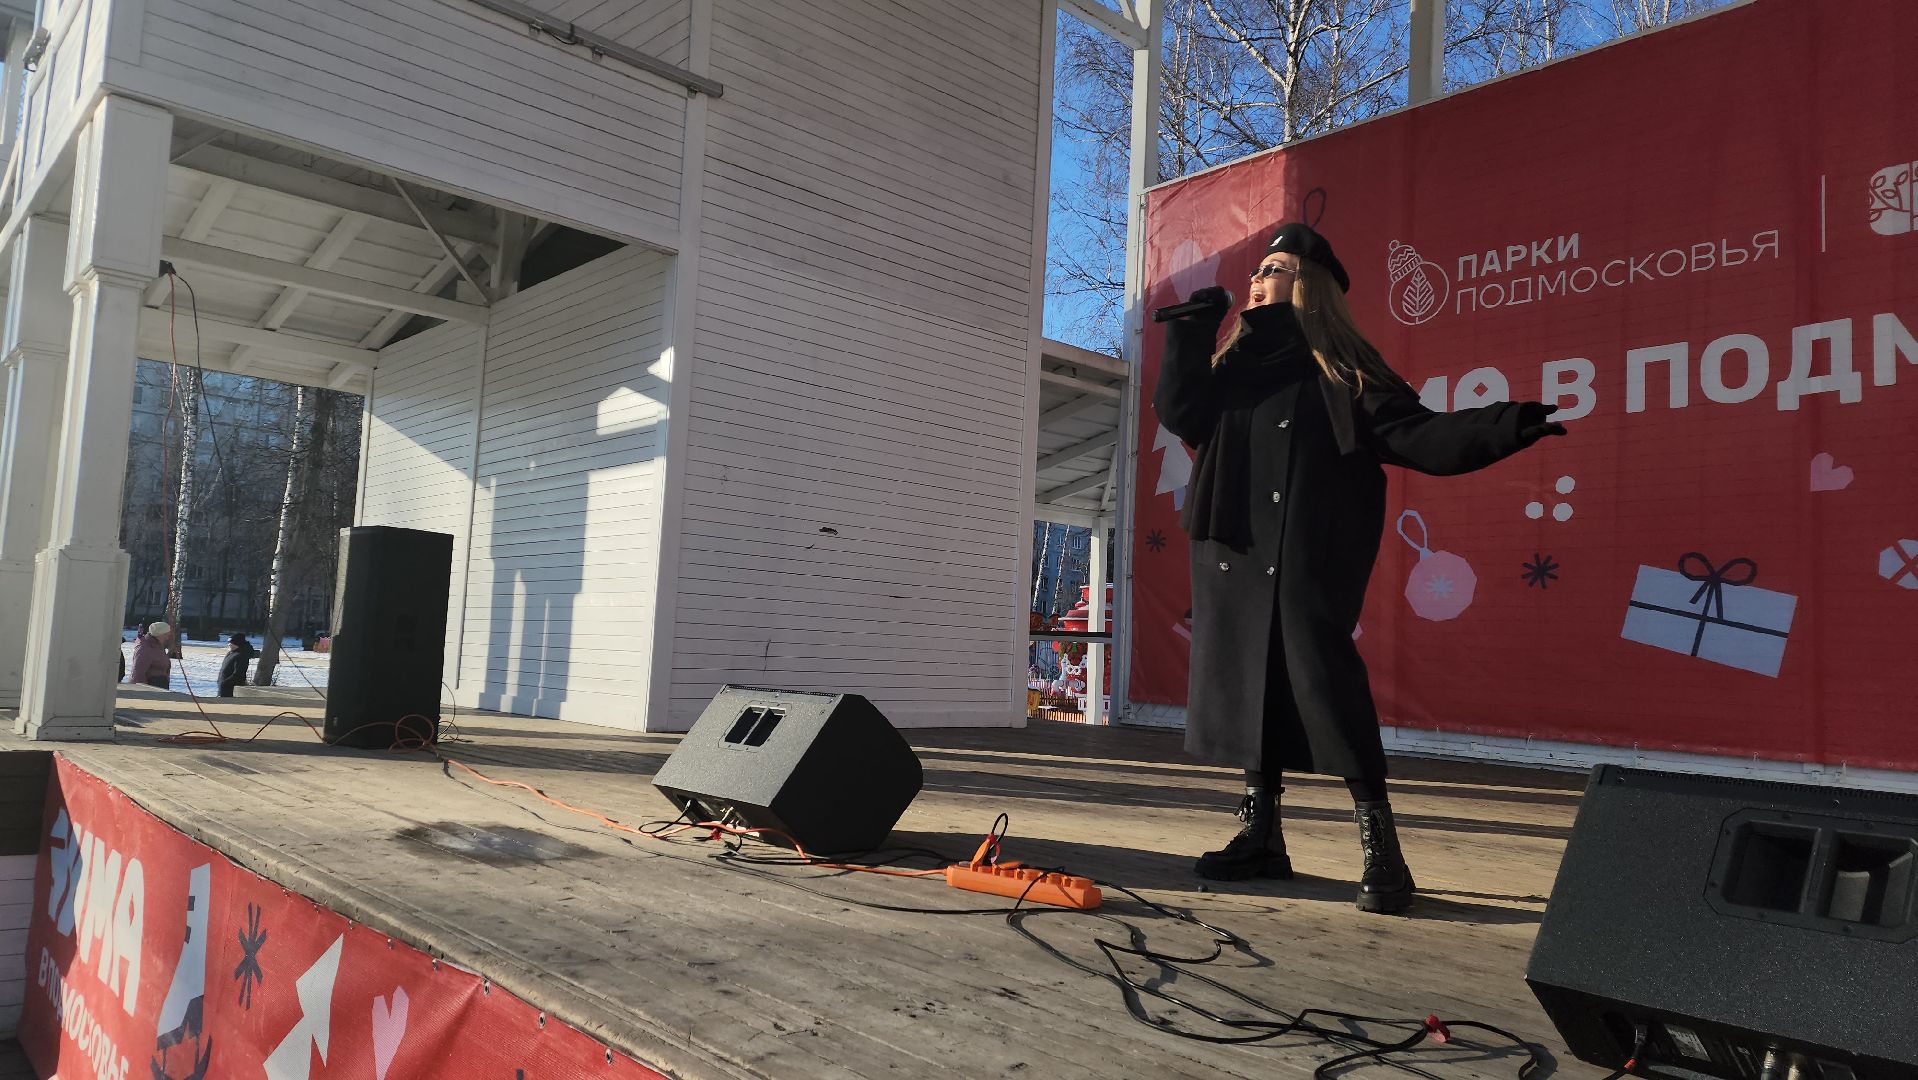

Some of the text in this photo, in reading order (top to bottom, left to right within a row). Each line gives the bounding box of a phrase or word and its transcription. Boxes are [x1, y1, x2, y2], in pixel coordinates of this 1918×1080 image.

[1456, 229, 1779, 315] ПОДМОСКОВЬЯ
[1457, 232, 1579, 282] ПАРКИ
[1542, 357, 1597, 423] В
